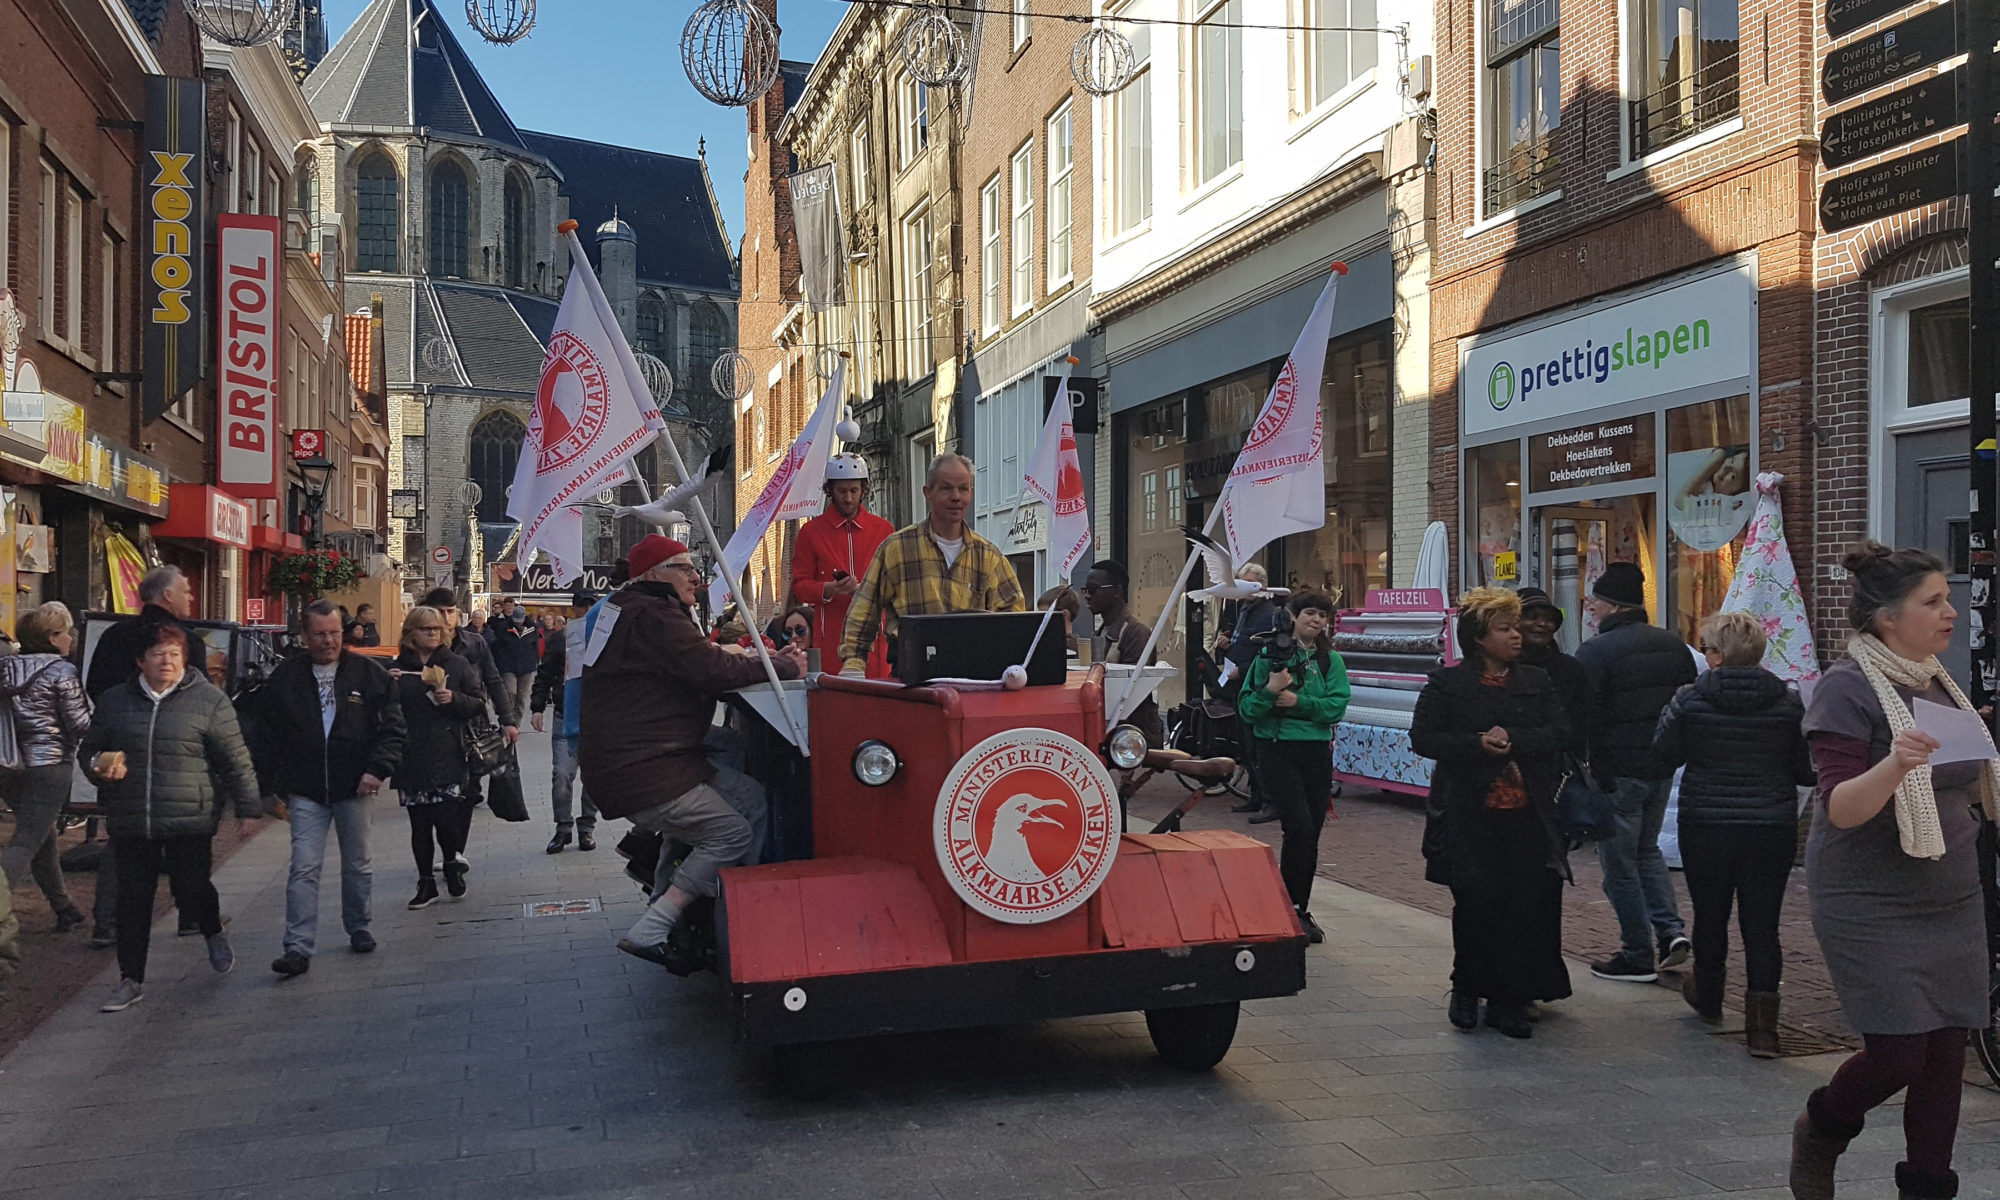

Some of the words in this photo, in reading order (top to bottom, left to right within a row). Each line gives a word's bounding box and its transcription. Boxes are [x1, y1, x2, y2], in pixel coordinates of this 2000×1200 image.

[1842, 39, 1882, 63] Overige
[1842, 55, 1882, 77] Overige
[1842, 70, 1880, 91] Station
[1842, 96, 1913, 127] Politiebureau
[1873, 115, 1898, 131] Kerk
[1841, 146, 1854, 157] St.
[1858, 121, 1919, 153] Josephkerk
[1840, 175, 1869, 192] Hofje
[1872, 170, 1890, 182] van
[1894, 155, 1940, 177] Splinter
[1840, 184, 1888, 207] Stadswal
[1840, 204, 1873, 221] Molen
[1876, 199, 1895, 211] van
[1899, 189, 1921, 204] Piet
[226, 256, 268, 453] BRISTOL
[1520, 318, 1711, 402] prettigslapen
[1548, 430, 1594, 448] Dekbedden
[1598, 423, 1633, 438] Kussens
[1566, 446, 1613, 462] Hoeslakens
[1550, 461, 1631, 483] Dekbedovertrekken
[216, 501, 244, 540] BRISTOL
[1378, 591, 1429, 606] TAFELZEIL
[955, 749, 1054, 824] MINISTERIE
[1060, 757, 1093, 792] VAN
[953, 838, 1068, 905] ALKMAARSE
[1070, 803, 1105, 880] ZAKEN
